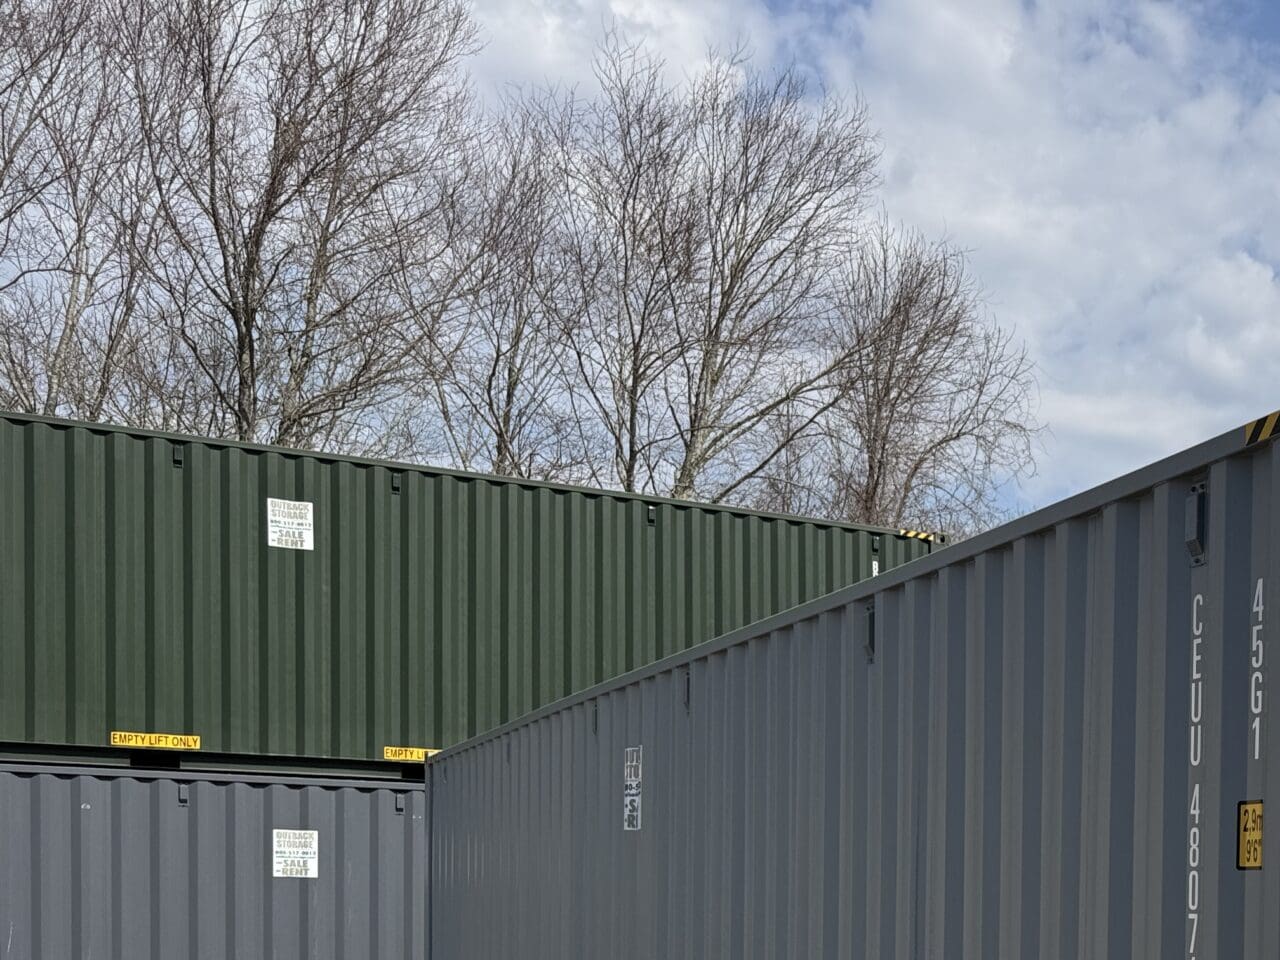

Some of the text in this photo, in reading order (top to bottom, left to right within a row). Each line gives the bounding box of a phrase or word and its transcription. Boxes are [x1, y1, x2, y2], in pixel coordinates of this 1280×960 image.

[1190, 594, 1203, 766] CEUU
[1250, 578, 1264, 760] 45G1
[112, 733, 198, 748] EMPTY LIFT ONLY
[385, 748, 414, 758] EMPTY
